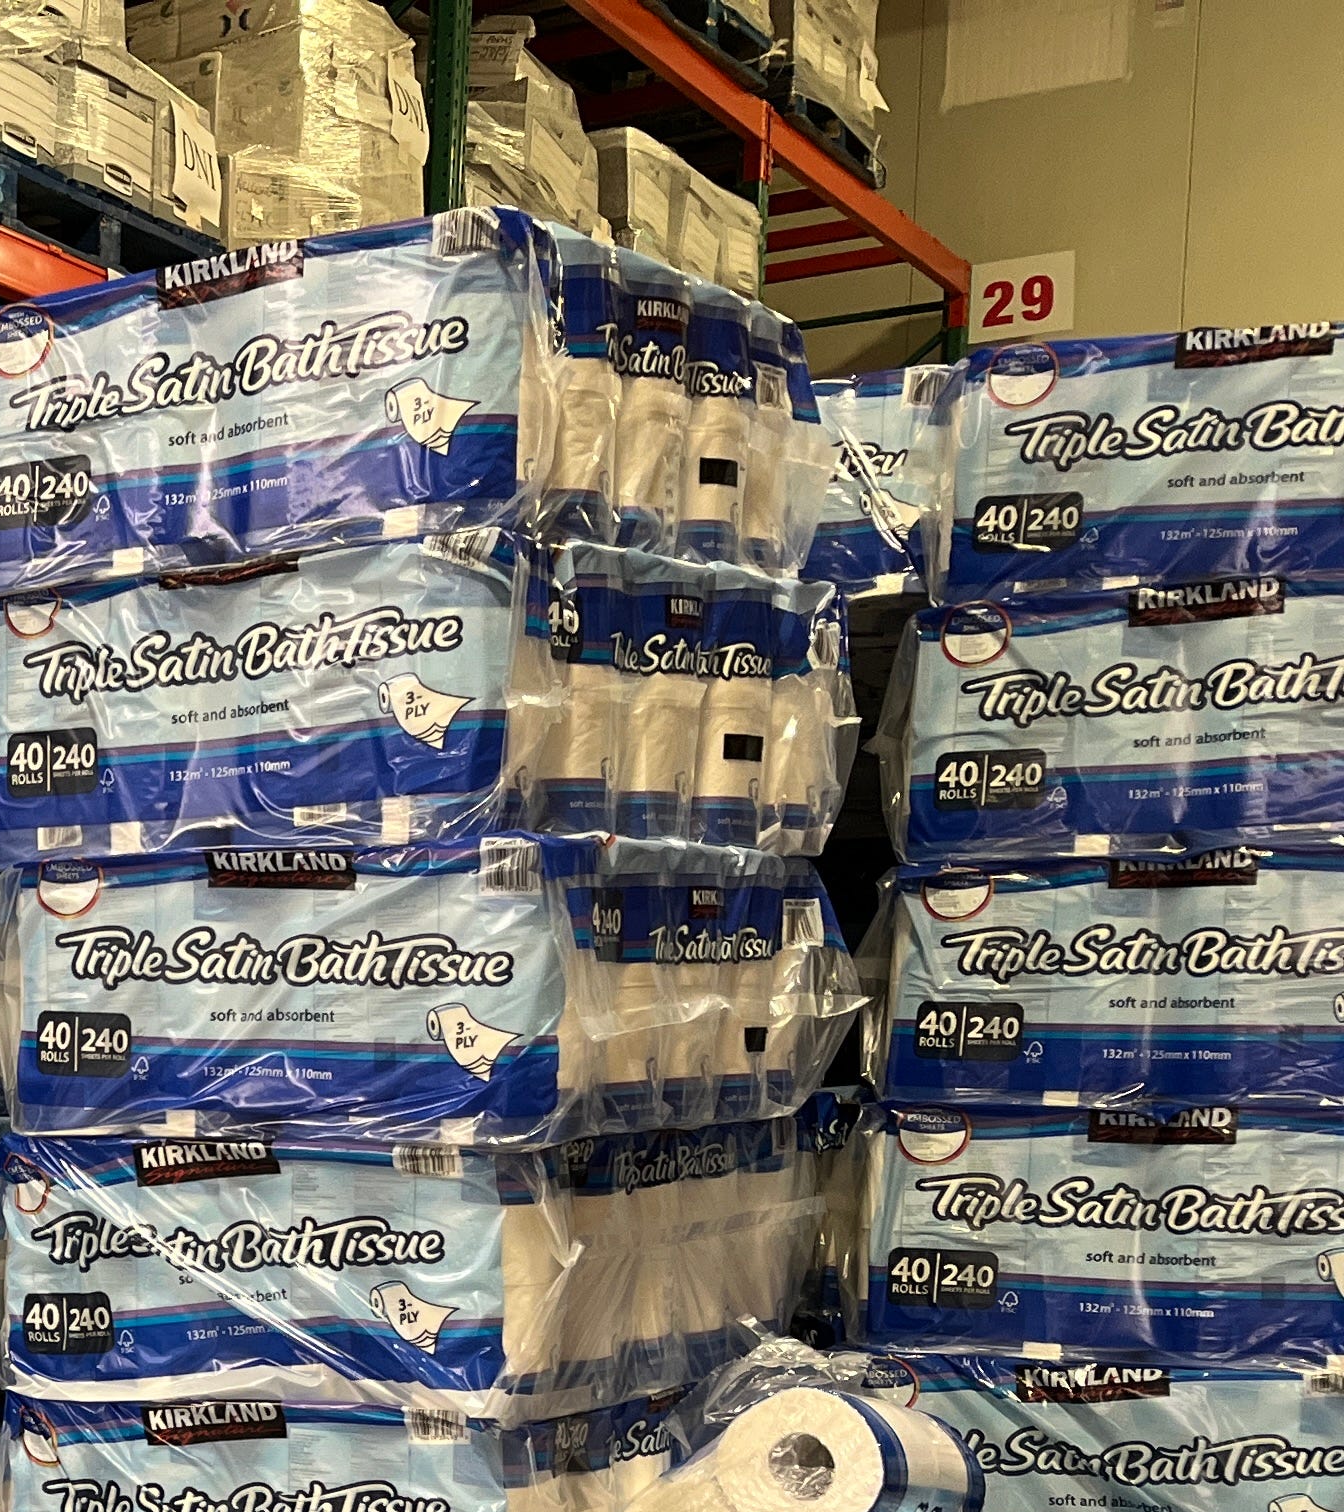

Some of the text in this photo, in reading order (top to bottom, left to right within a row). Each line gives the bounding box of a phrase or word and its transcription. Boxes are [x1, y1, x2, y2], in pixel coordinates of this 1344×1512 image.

[182, 128, 216, 191] DNI
[164, 239, 299, 291] KIRKLAND
[981, 275, 1055, 328] 29
[11, 311, 468, 431] Triple Satin Bath Tissue
[413, 408, 434, 424] PLY
[168, 413, 289, 447] soft absorbent
[1005, 405, 1244, 471] Triple Satin
[43, 471, 89, 500] 240
[1168, 471, 1305, 488] soft and absorbent
[977, 505, 1079, 531] 40 240
[11, 743, 96, 769] 40 240
[254, 760, 290, 774] 110mm
[12, 771, 44, 785] ROLLS
[213, 851, 347, 872] KIRKLAND
[56, 925, 514, 989] Triple Satin Bath Tissue
[1185, 925, 1294, 977] Bath
[210, 1008, 335, 1023] soft and absorbent
[919, 1010, 1019, 1040] 40 240
[919, 1037, 955, 1048] ROLLS
[1192, 1049, 1232, 1061] 110mm
[141, 1142, 267, 1168] KIRKLAND
[32, 1211, 445, 1271] Triple Bath Tissue
